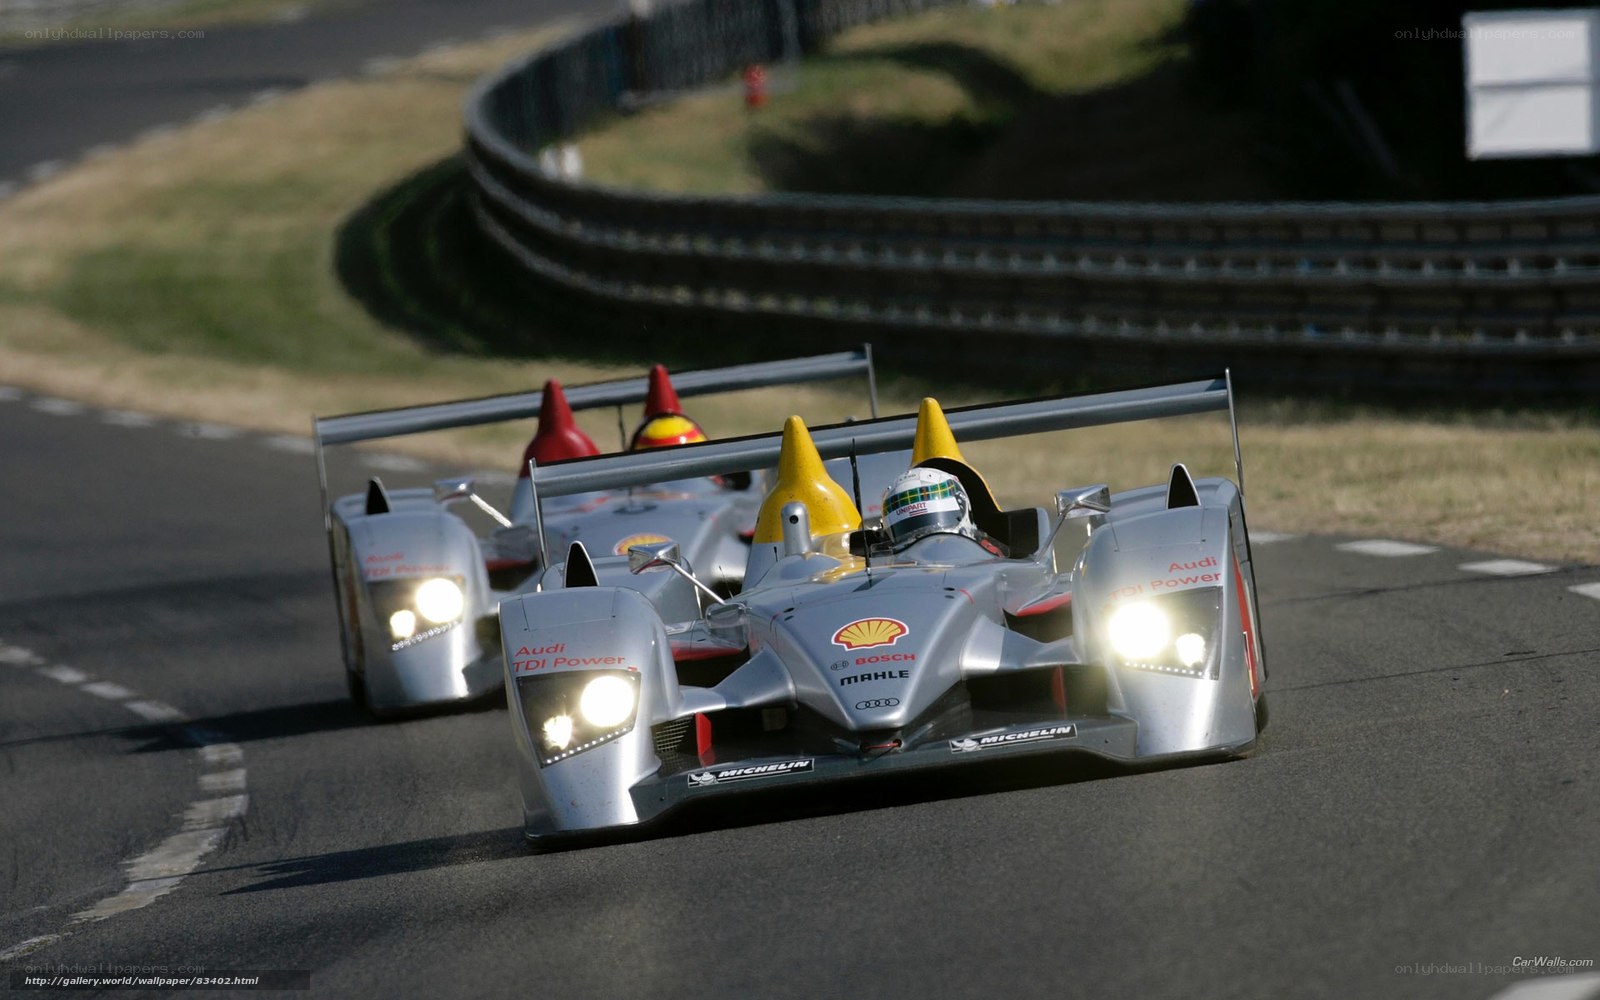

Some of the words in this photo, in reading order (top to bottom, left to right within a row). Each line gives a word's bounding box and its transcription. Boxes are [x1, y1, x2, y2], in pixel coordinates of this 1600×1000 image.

[896, 503, 927, 516] UNIPART
[1168, 556, 1218, 574] Audi
[1150, 572, 1221, 591] Power
[514, 643, 566, 658] Audi
[512, 658, 546, 673] TDI
[553, 656, 625, 668] Power
[855, 653, 916, 666] BOSCH
[840, 670, 910, 687] MAHLE
[980, 726, 1072, 744] MICHELIN
[718, 760, 810, 778] MICHELIN
